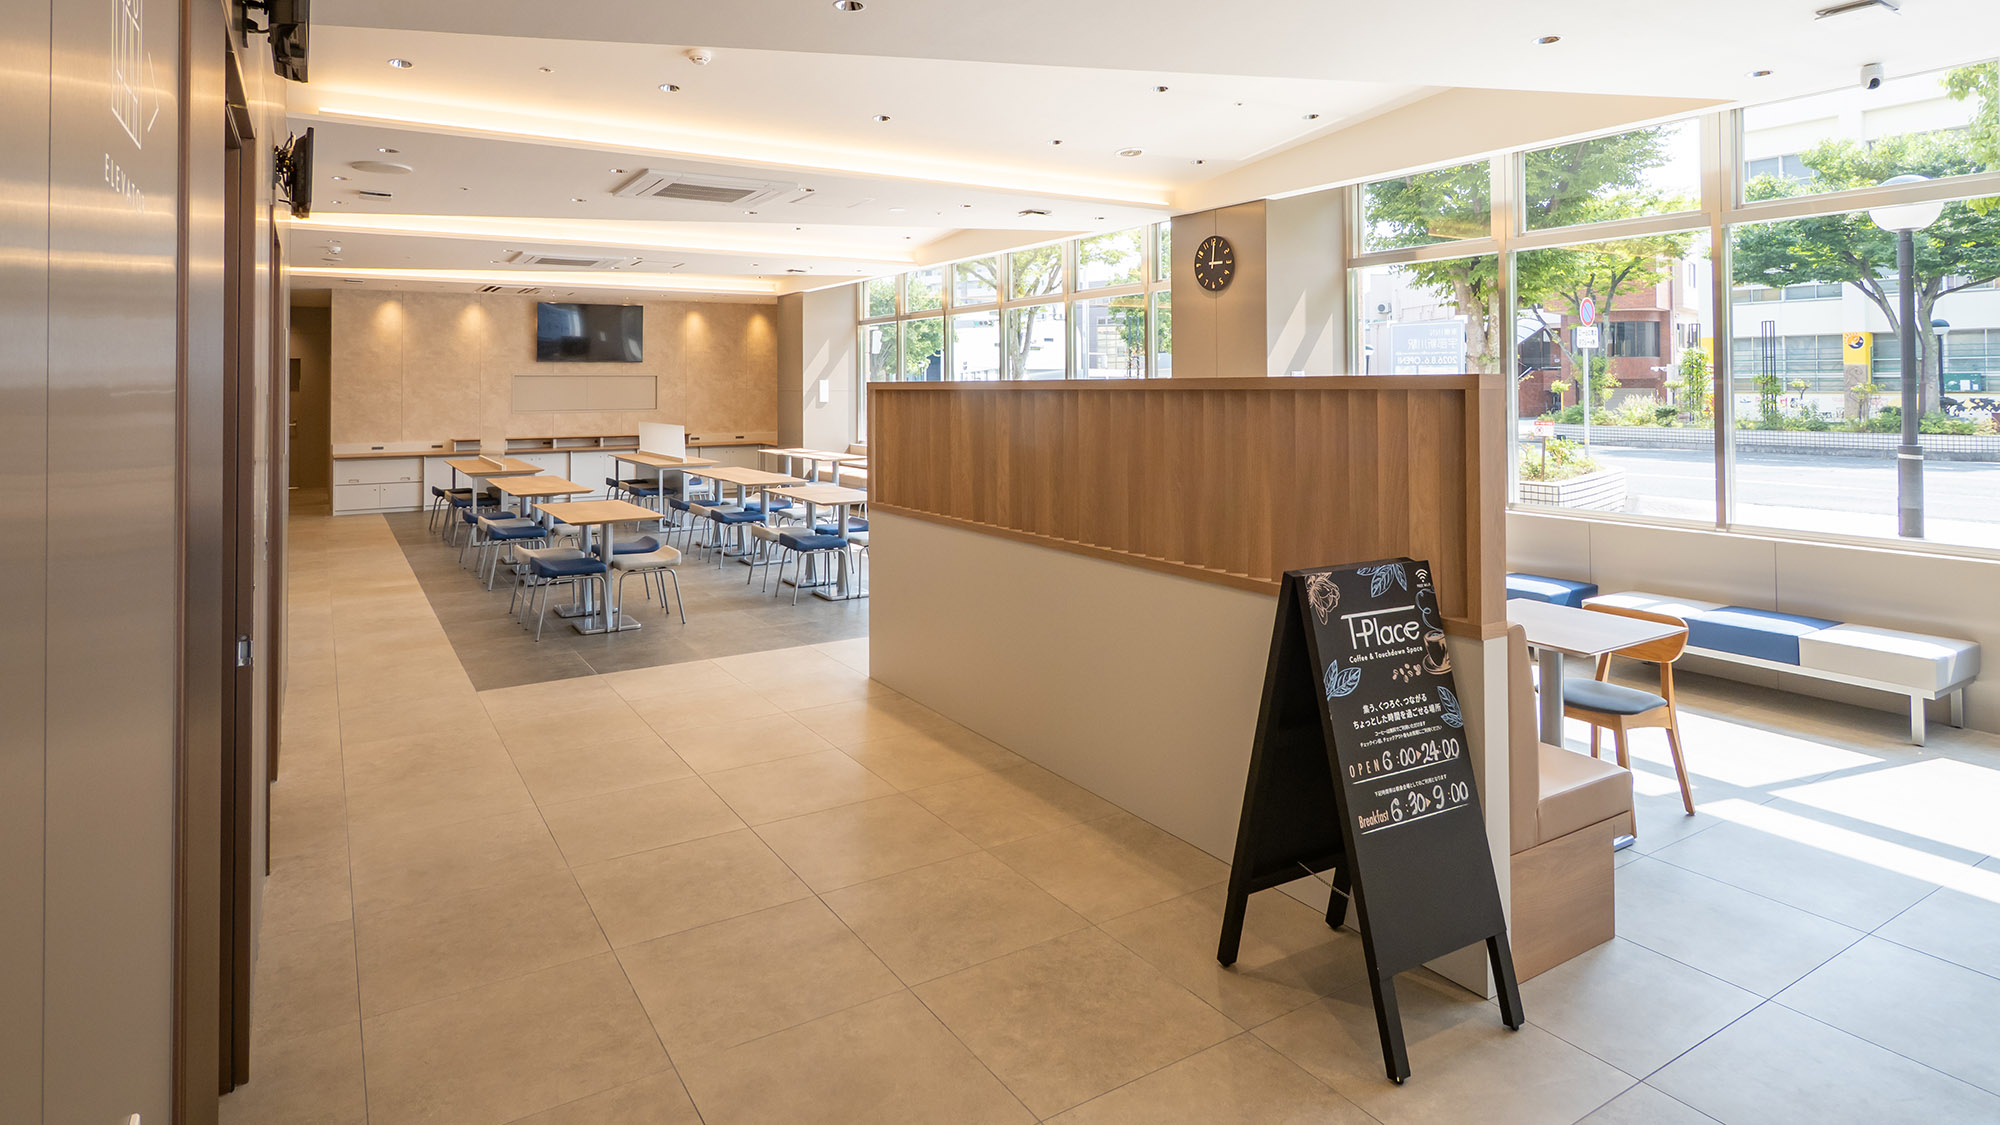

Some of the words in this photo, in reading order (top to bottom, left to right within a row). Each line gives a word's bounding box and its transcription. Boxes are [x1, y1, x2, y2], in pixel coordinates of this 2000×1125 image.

[1349, 654, 1368, 663] Coffee
[1369, 652, 1374, 660] &
[1375, 648, 1406, 659] Touchdown
[1406, 645, 1423, 655] Space
[1353, 703, 1442, 730] ちょっとした時間を過ごせる場所
[1348, 758, 1380, 778] OPEN
[1358, 809, 1390, 829] Breakfast
